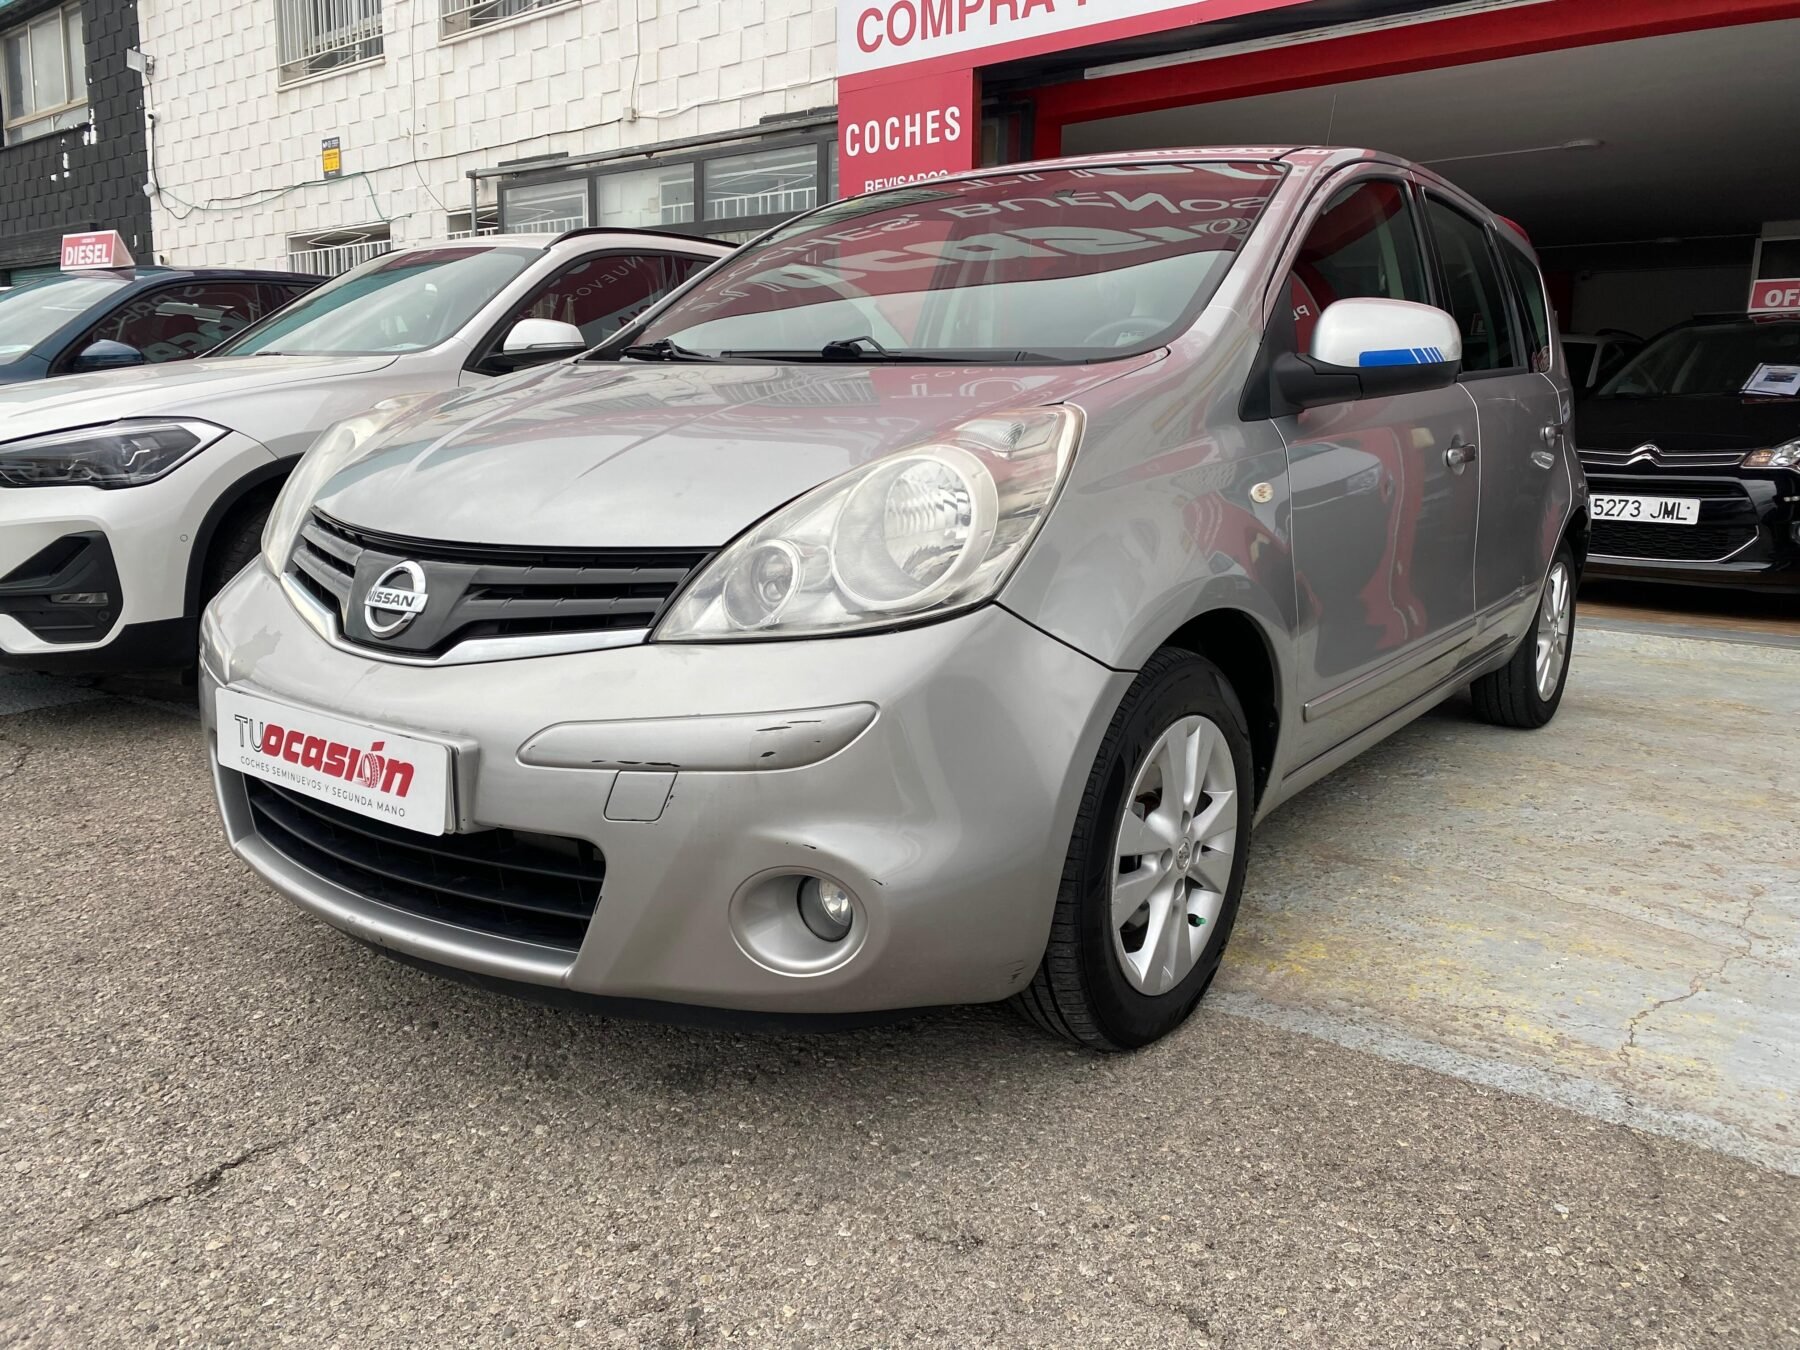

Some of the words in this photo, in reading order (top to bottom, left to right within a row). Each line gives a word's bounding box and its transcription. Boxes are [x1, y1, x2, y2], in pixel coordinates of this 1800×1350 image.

[845, 106, 961, 157] COCHES
[64, 243, 109, 266] DIESEL
[1764, 288, 1800, 308] OF
[1593, 498, 1642, 518] 5273
[1649, 501, 1688, 521] JML
[368, 590, 415, 608] NISSAN
[240, 756, 270, 773] COCHES
[272, 766, 322, 791] SEMINUEVOS
[324, 783, 330, 792] Y
[332, 786, 373, 808] SEGUNDA
[376, 801, 406, 817] MANO
